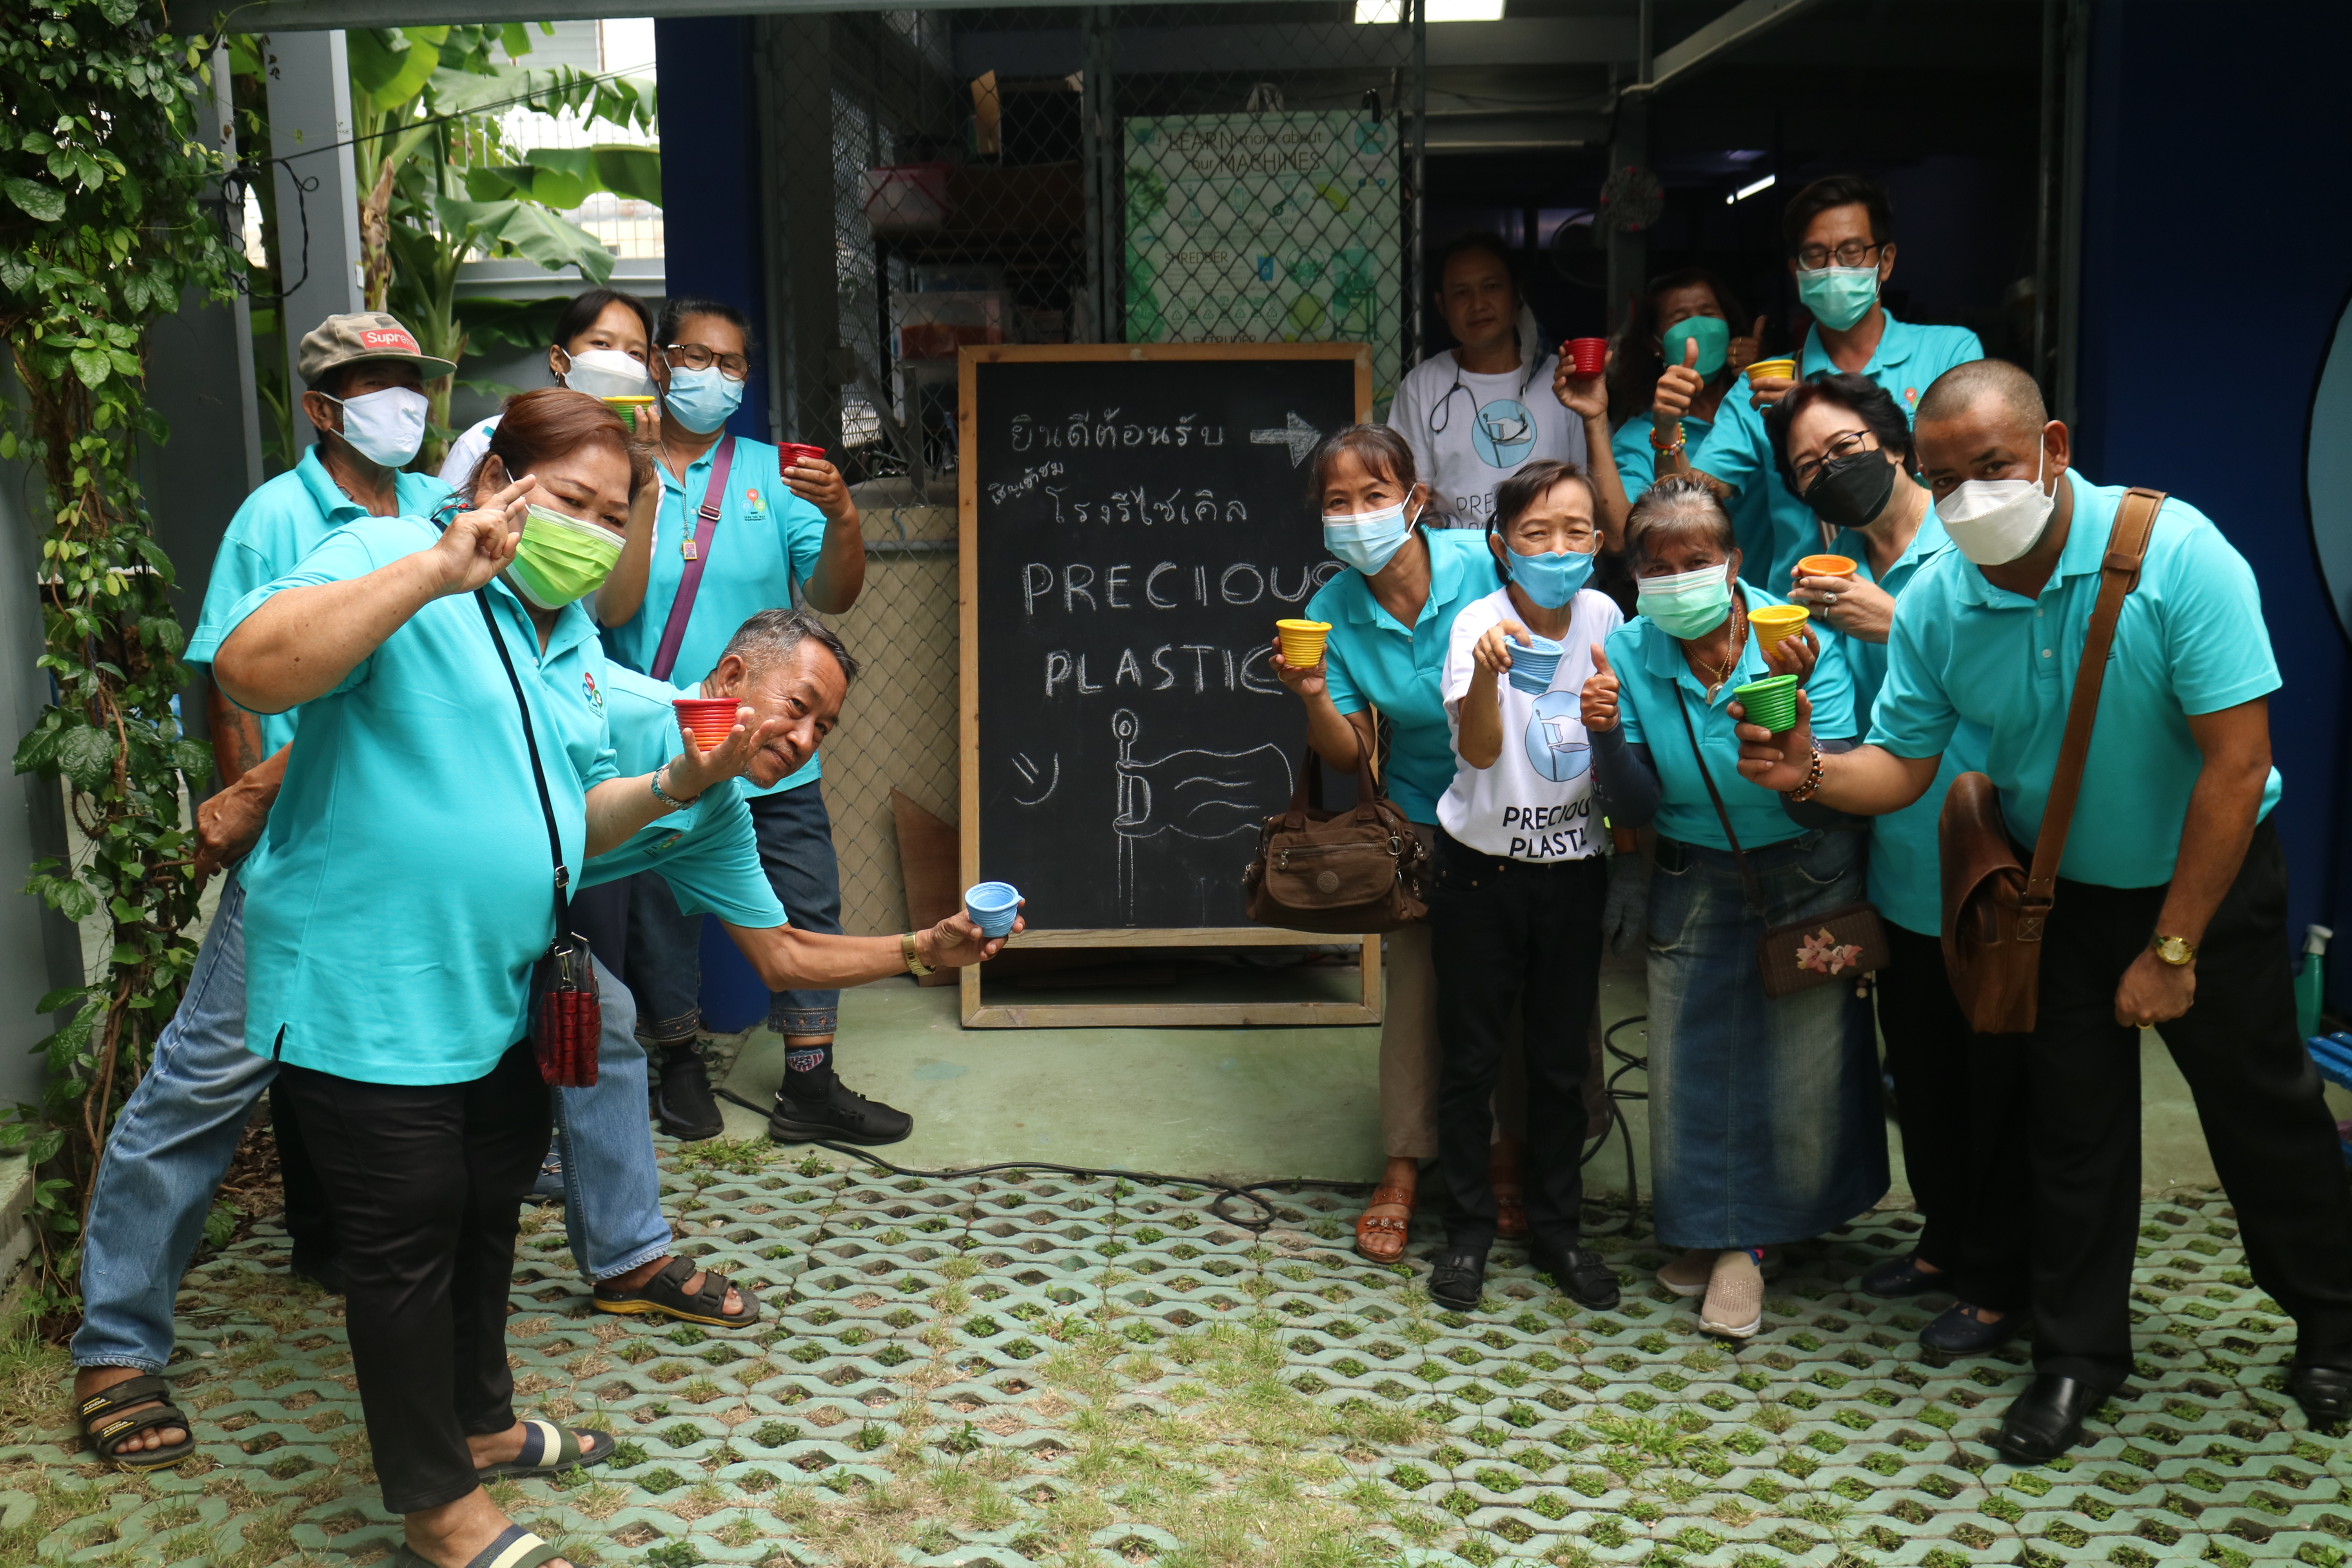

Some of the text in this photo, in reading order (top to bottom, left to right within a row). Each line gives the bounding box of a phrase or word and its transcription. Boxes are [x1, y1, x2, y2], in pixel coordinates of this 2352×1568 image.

[1169, 130, 1322, 151] LEARN more about
[1192, 151, 1320, 172] our MACHINES
[1165, 251, 1229, 265] SHREDDER
[1012, 408, 1223, 451] ยินดีต้อนรับ
[1045, 643, 1283, 697] PLASTIC
[1503, 797, 1593, 830] PRECIOU
[1509, 827, 1587, 858] PLASTI
[83, 1398, 106, 1412] ADDA
[103, 1421, 128, 1435] ADDA
